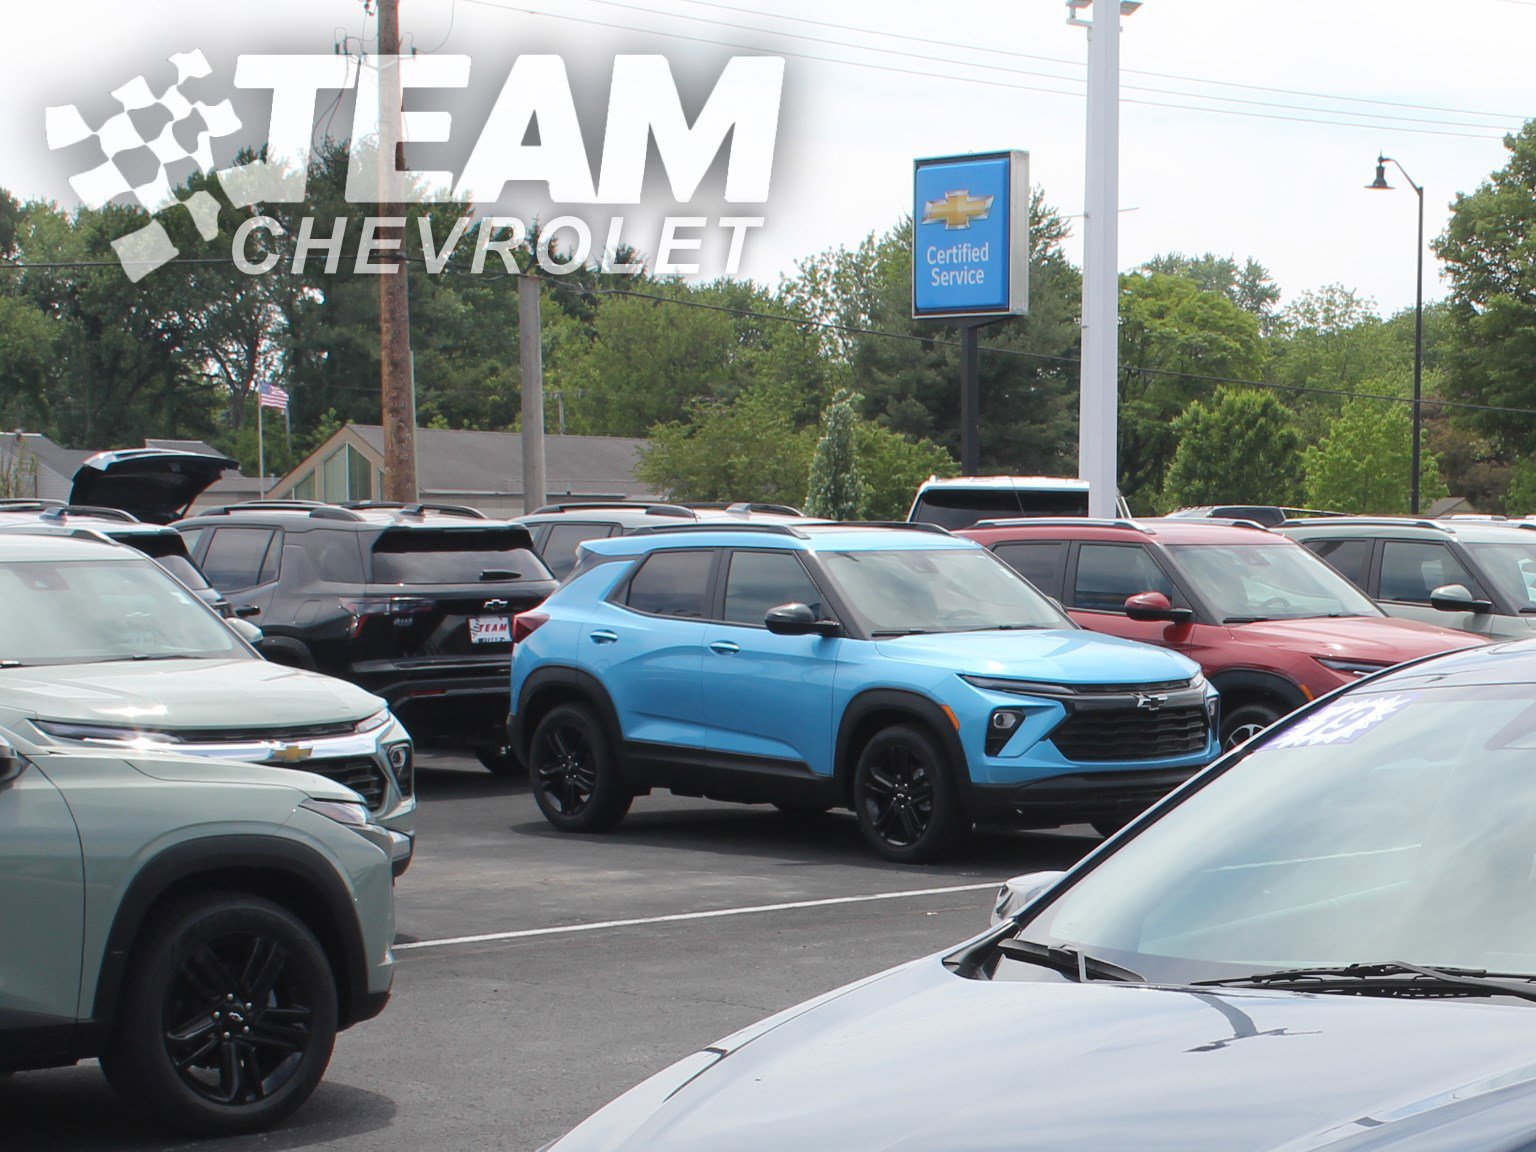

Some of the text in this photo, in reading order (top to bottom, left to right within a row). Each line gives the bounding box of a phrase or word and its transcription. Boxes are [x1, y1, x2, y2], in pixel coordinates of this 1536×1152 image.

[926, 242, 989, 265] Certified
[931, 266, 985, 287] Service
[478, 623, 508, 633] TEAM
